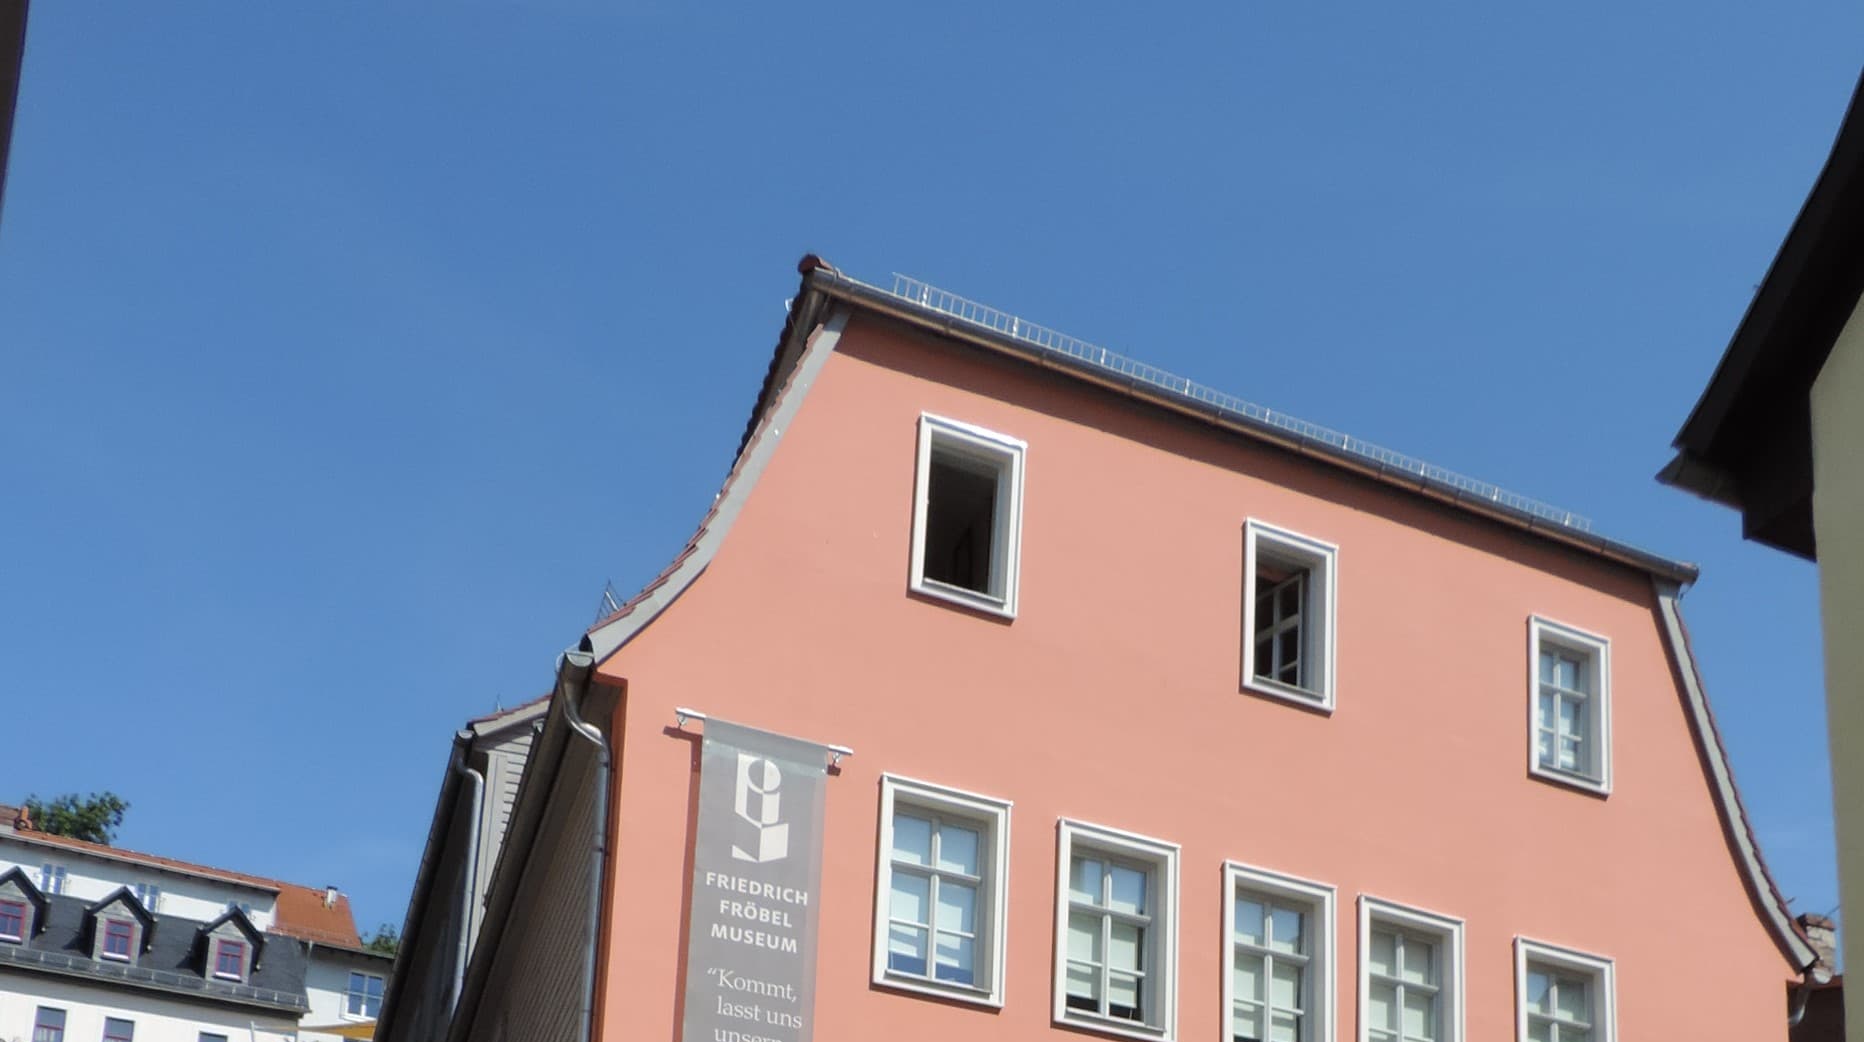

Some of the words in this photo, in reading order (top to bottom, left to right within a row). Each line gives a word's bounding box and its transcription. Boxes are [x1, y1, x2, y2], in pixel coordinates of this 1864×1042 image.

[706, 871, 808, 906] FRIEDRICH
[720, 900, 792, 928] FRÖBEL
[711, 923, 797, 953] MUSEUM
[717, 995, 761, 1021] lasst
[766, 1010, 802, 1029] uns
